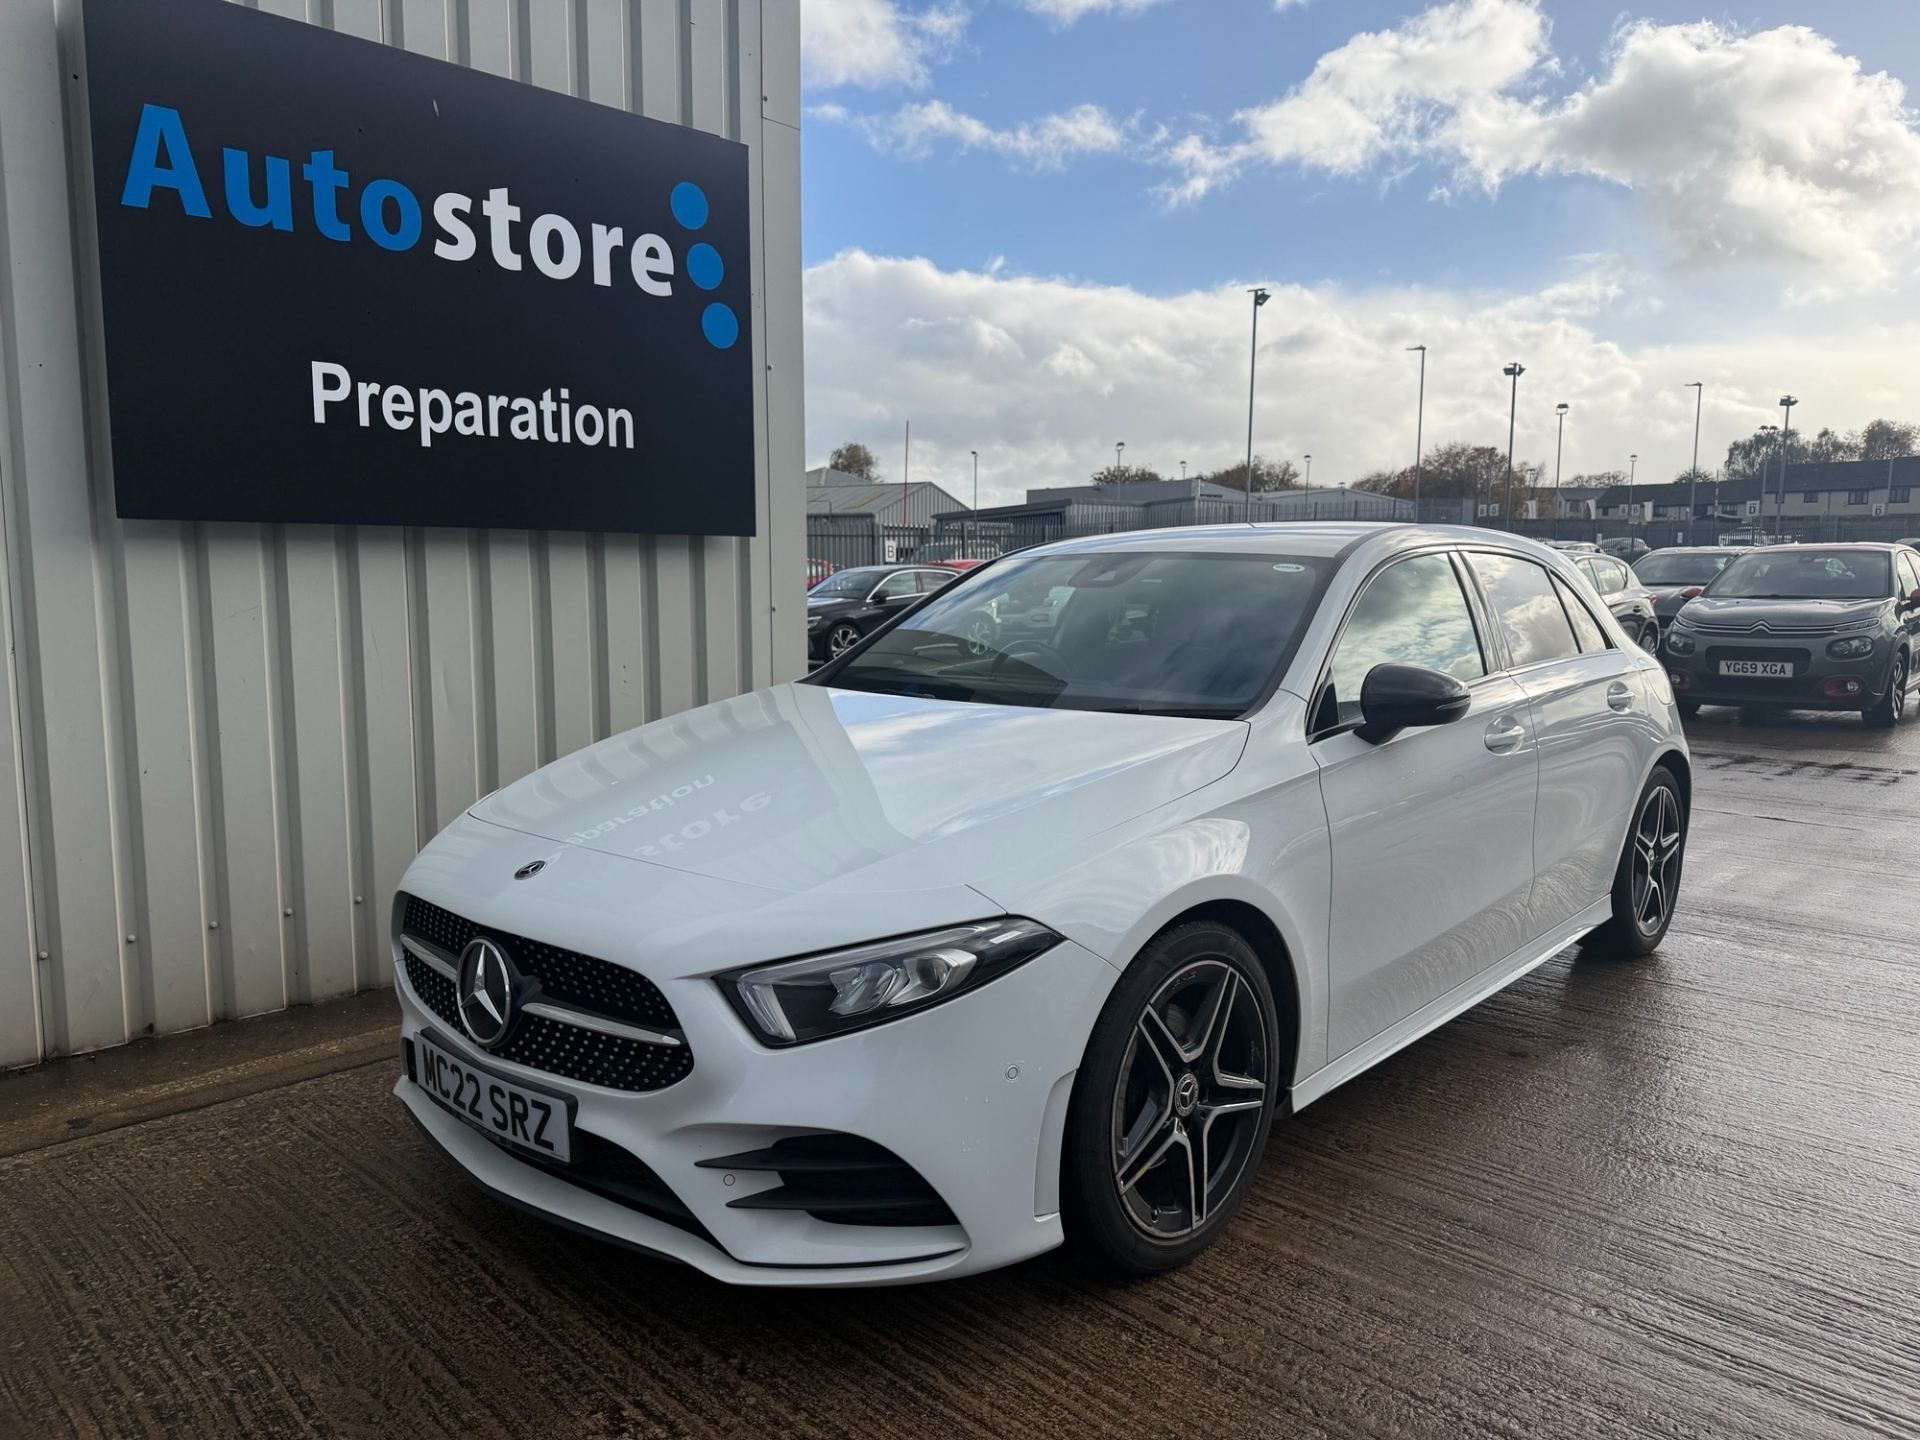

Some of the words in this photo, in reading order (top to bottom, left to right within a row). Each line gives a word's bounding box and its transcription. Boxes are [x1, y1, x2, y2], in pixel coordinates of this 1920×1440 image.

[121, 103, 675, 297] Autostore
[311, 360, 635, 448] Preparation
[887, 545, 894, 558] B
[1725, 662, 1758, 674] YG69
[1761, 663, 1786, 675] XGA
[422, 1043, 484, 1121] MC22
[489, 1084, 554, 1151] SRZ
